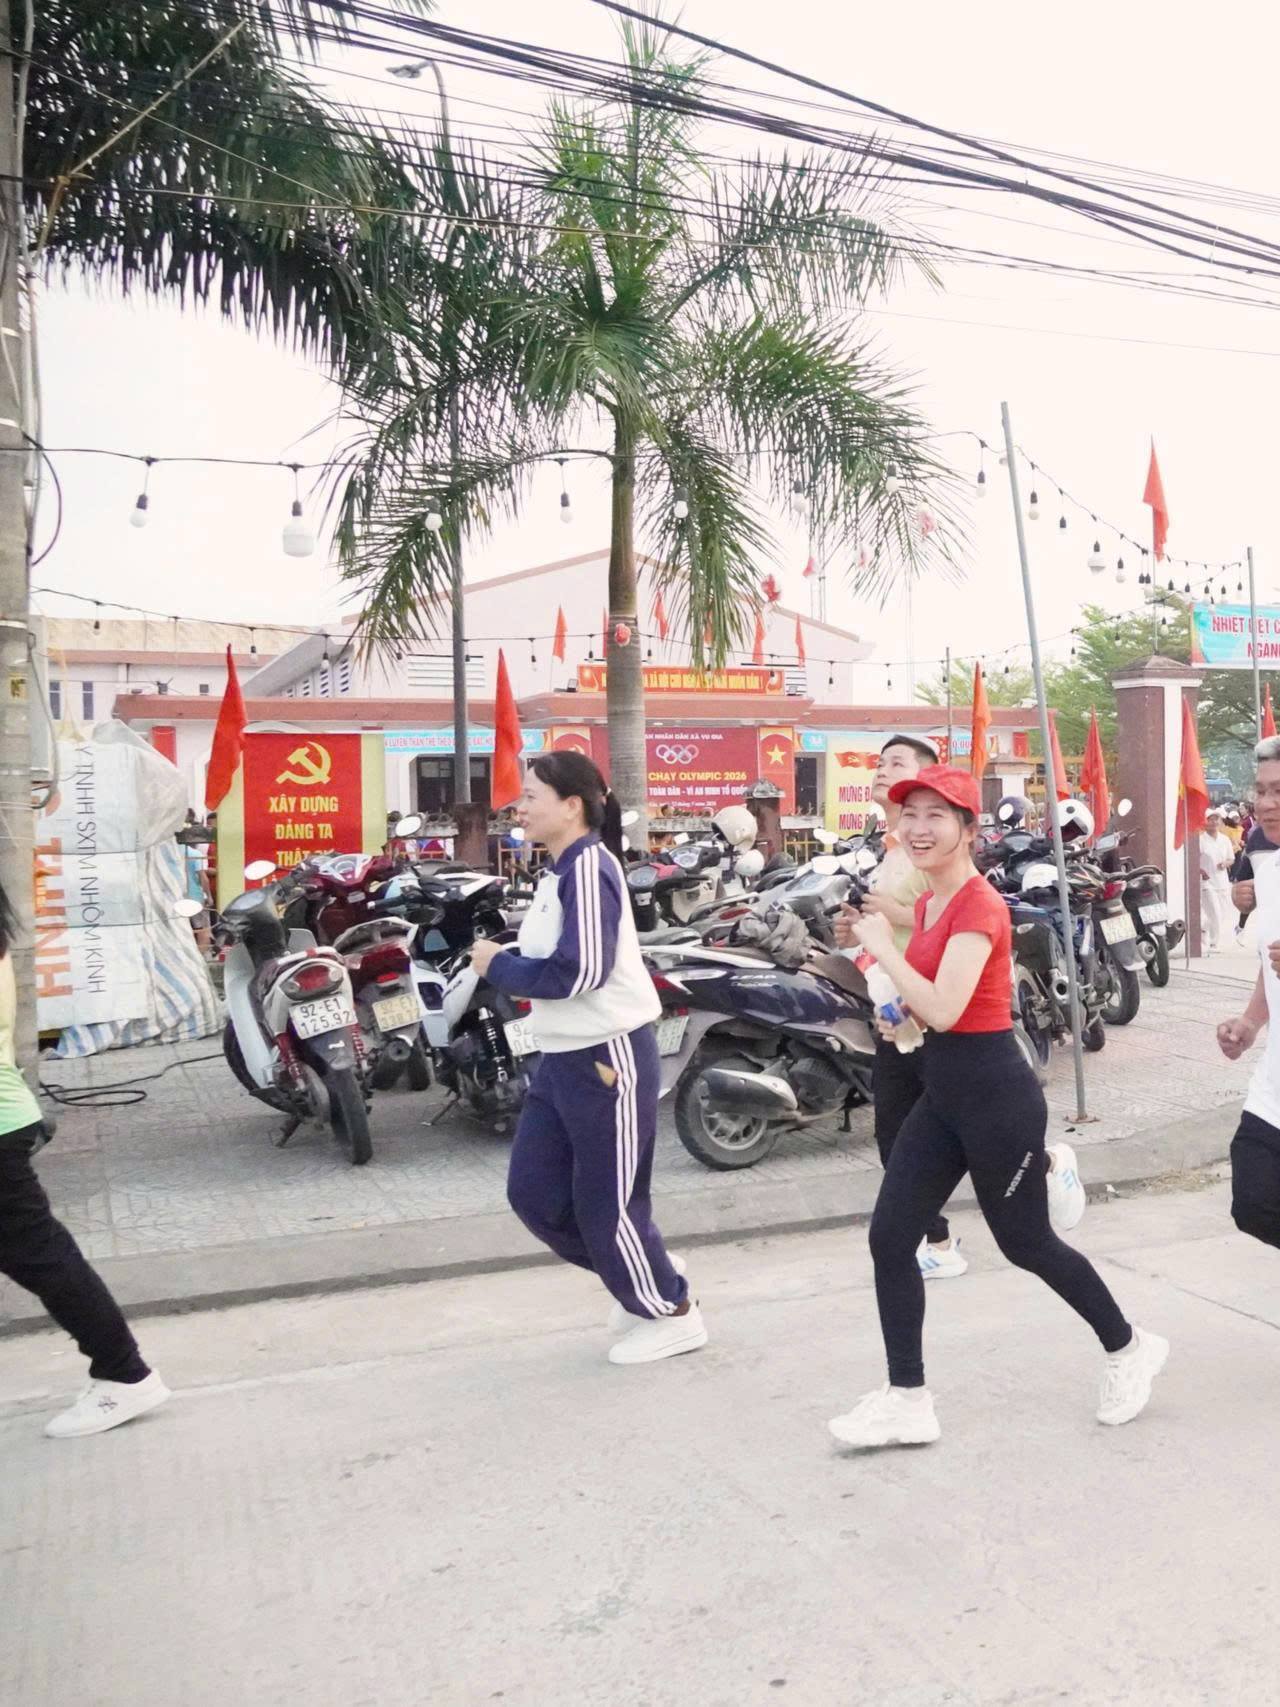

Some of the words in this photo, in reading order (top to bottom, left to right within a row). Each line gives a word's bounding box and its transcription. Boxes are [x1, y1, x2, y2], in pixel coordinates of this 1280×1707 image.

[1212, 615, 1245, 637] NHIỆT
[648, 772, 676, 783] CHẠY
[679, 772, 721, 780] OLYMPIC
[723, 772, 747, 780] 2026
[269, 793, 297, 813] XÂY
[301, 795, 339, 816] DỰNG
[275, 818, 314, 839] ĐẢNG
[317, 823, 333, 839] TA
[300, 998, 341, 1018] 92-E1
[301, 1010, 351, 1036] 125.92
